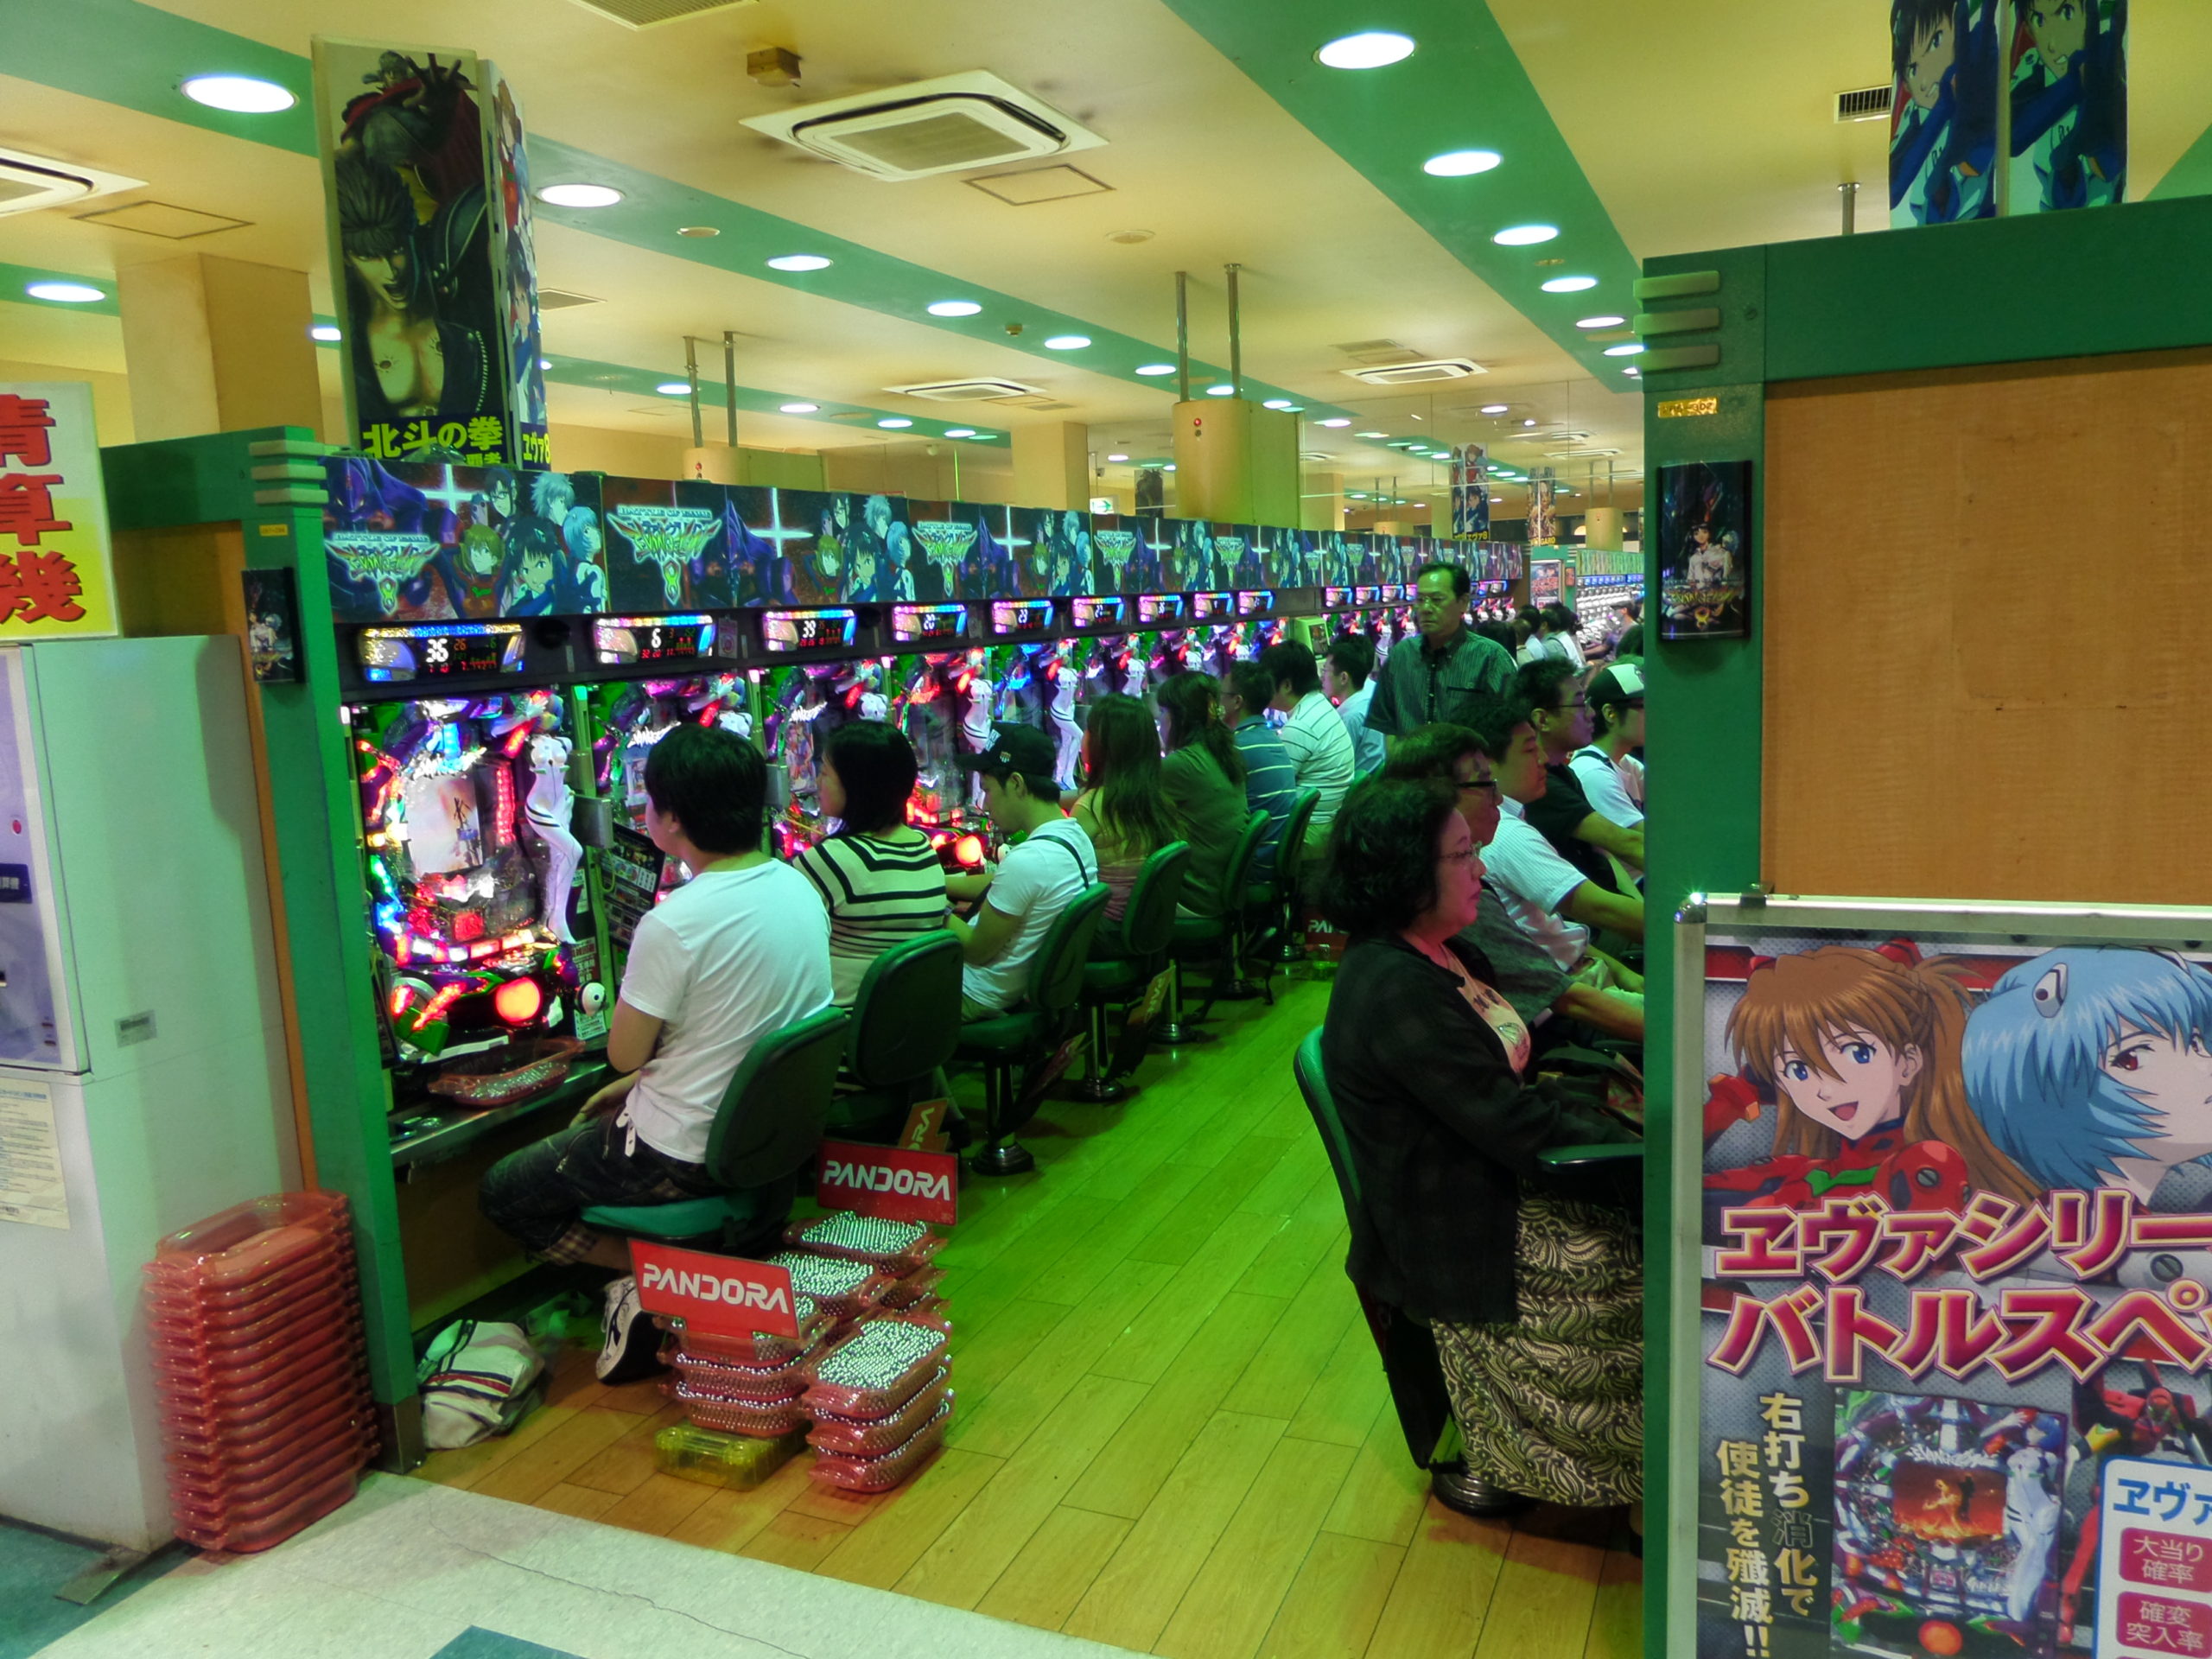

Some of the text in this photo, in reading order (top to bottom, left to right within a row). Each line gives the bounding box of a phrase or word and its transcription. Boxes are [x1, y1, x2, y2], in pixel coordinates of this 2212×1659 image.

[363, 416, 503, 460] 北斗の拳
[823, 1160, 950, 1201] PANDORA
[643, 1262, 789, 1314] PANDORA
[1707, 1279, 2212, 1382] バトルスペ
[2133, 1535, 2203, 1563] 大当り
[2142, 1559, 2195, 1585] 確率
[2139, 1600, 2192, 1629] 確変
[2126, 1623, 2204, 1652] 突入率
